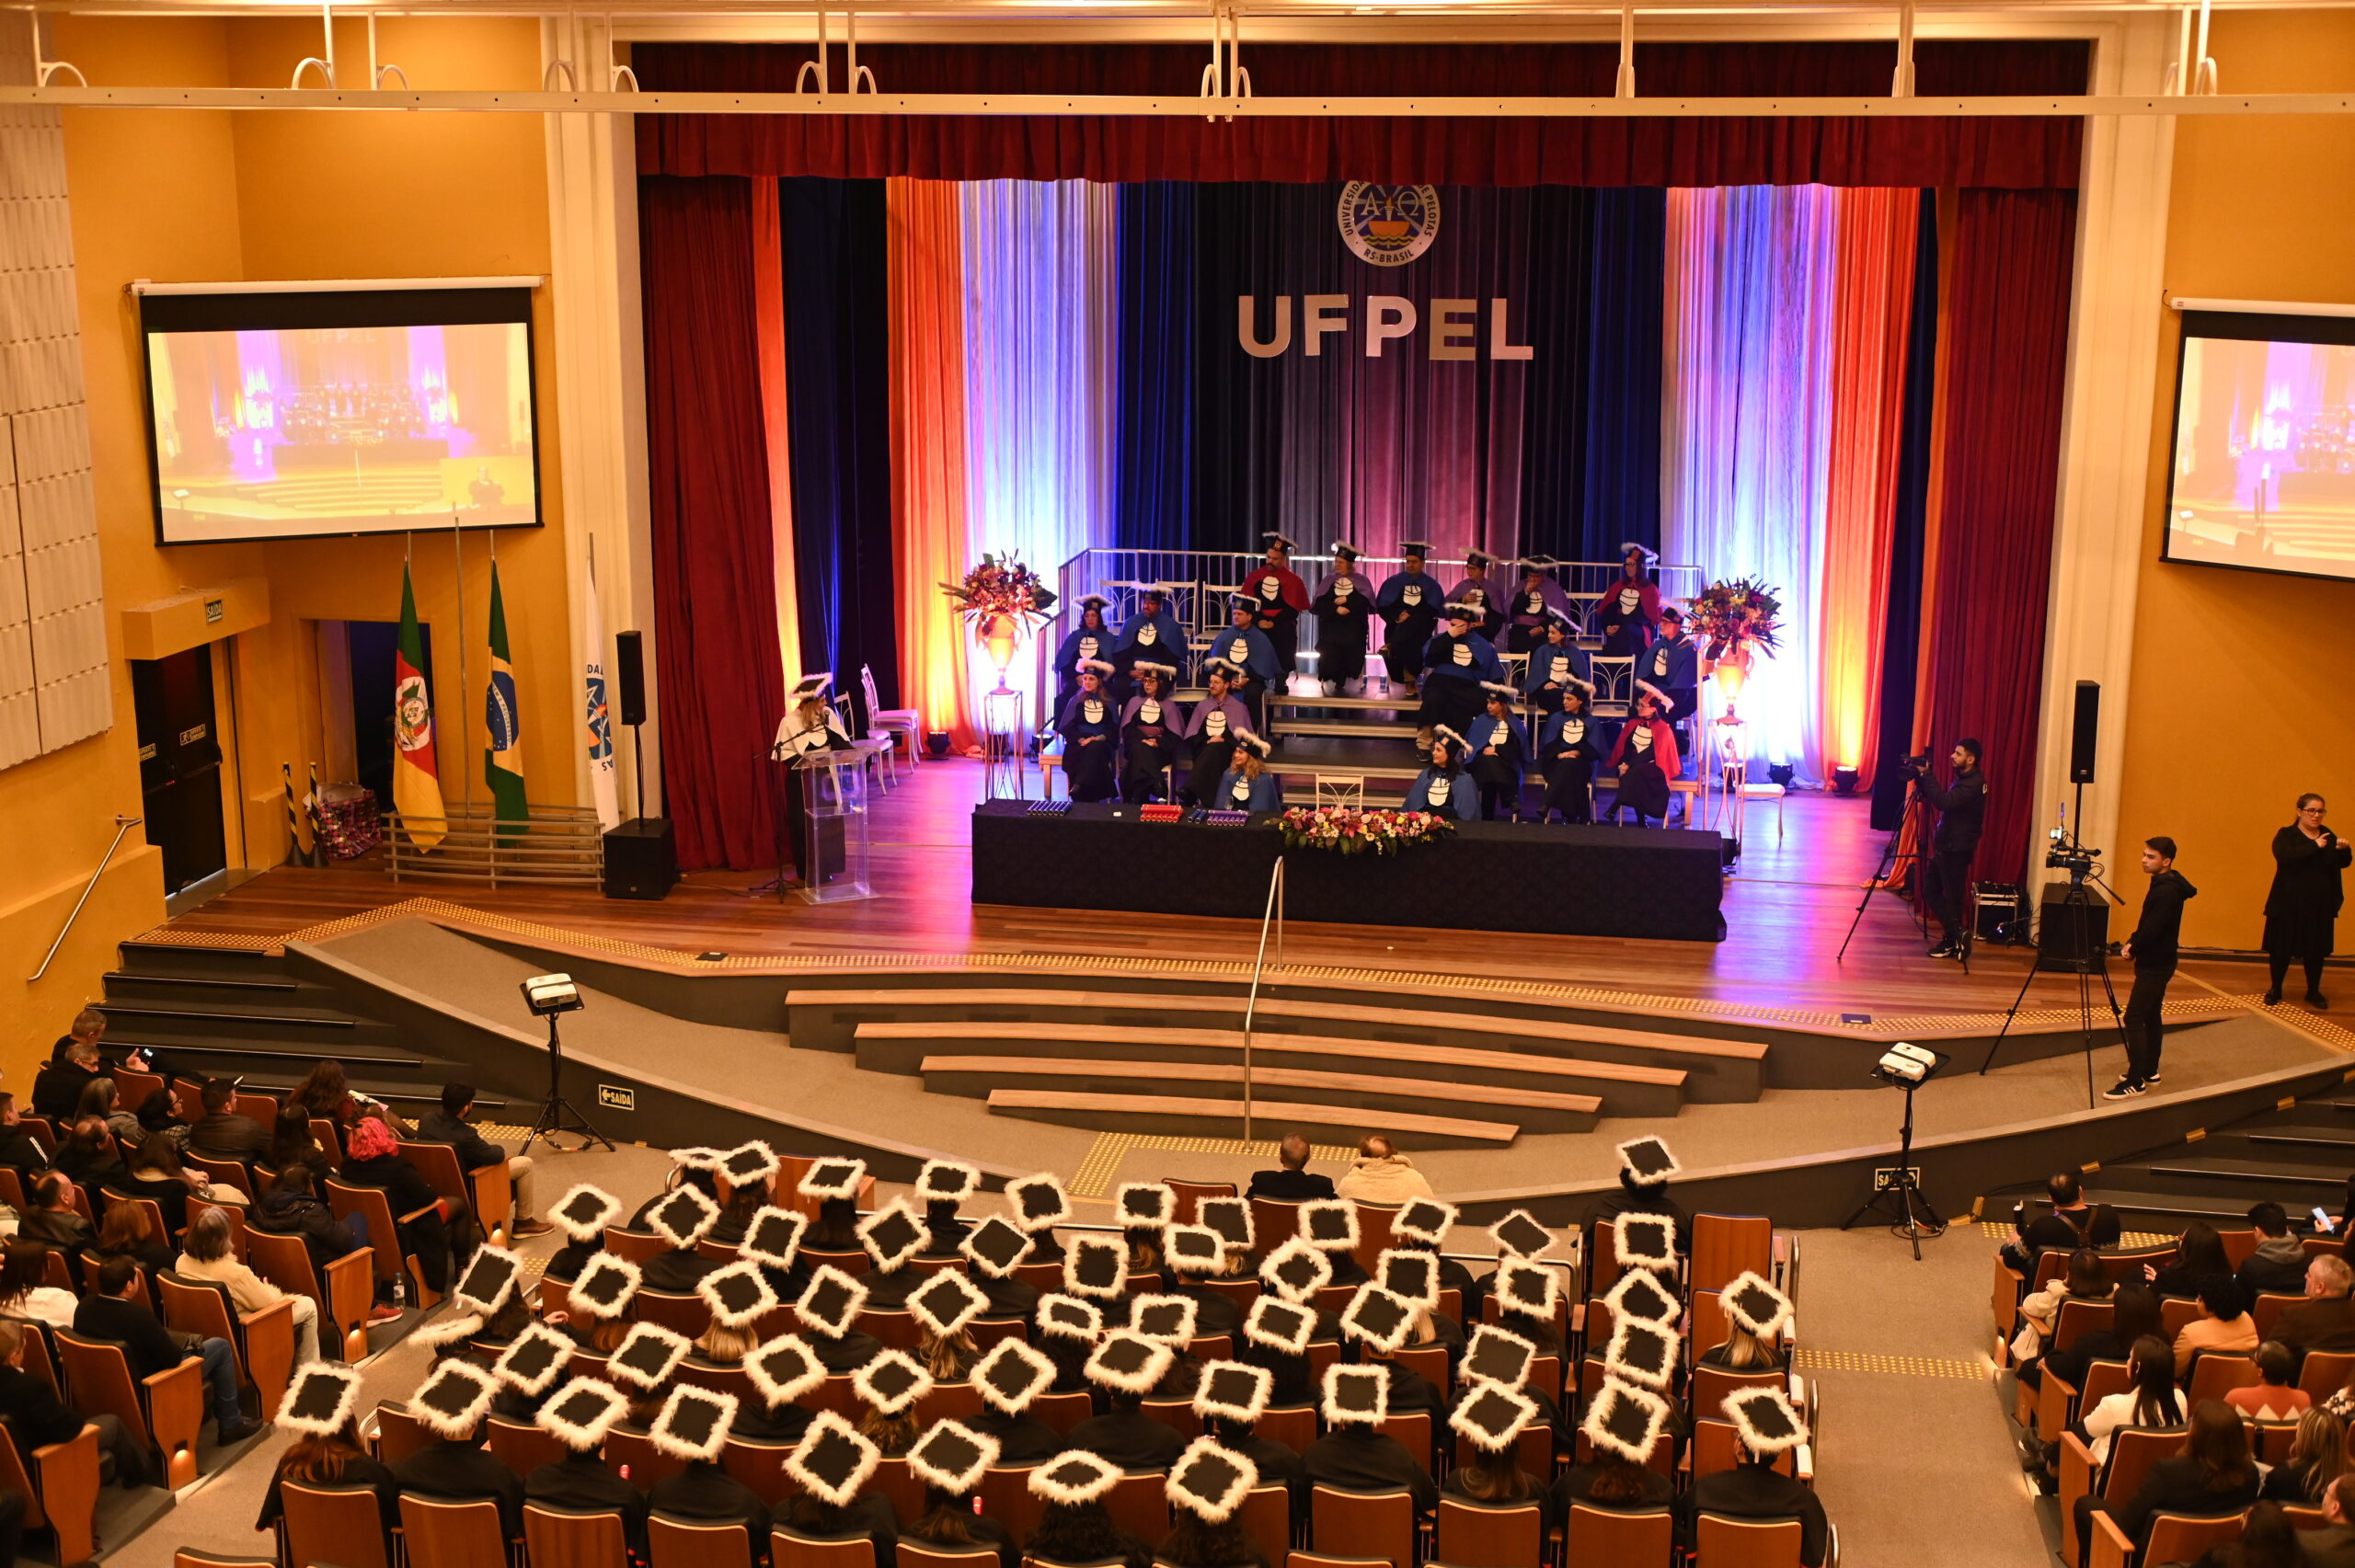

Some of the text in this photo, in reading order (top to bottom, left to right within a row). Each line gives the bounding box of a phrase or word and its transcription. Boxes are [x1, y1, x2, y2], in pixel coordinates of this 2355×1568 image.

[1424, 194, 1437, 237] PELOTAS
[1363, 248, 1414, 263] RS-BRASIL
[1238, 293, 1534, 361] UFPEL
[611, 1091, 632, 1105] SAÍDA
